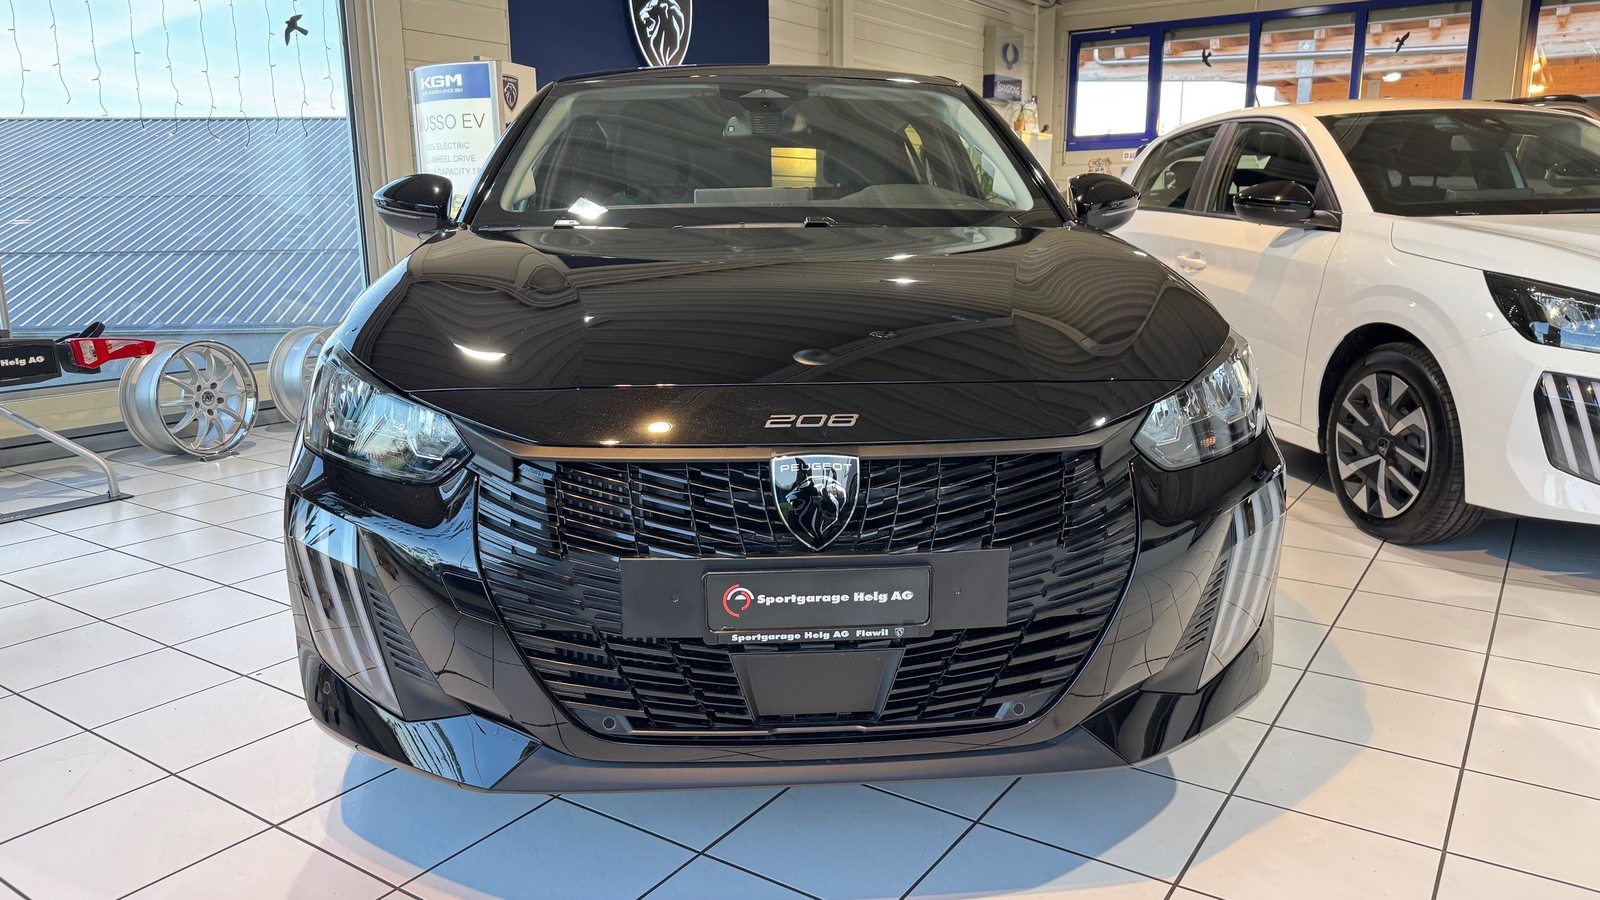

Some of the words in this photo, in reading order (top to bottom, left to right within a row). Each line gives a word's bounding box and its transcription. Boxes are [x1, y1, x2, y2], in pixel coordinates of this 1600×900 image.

[421, 74, 462, 89] KGM
[462, 113, 485, 129] EV
[436, 141, 470, 151] ELECTRIC
[453, 154, 476, 163] DRIVE
[437, 168, 470, 176] CAPACITY
[764, 413, 859, 428] 208
[780, 462, 852, 473] PEUGEOT
[757, 594, 849, 605] Sportgarage
[853, 591, 888, 603] Helg
[890, 590, 914, 601] AG
[731, 632, 801, 642] Sportgarage
[804, 631, 831, 640] Helg
[833, 630, 850, 638] AG
[855, 629, 889, 637] Flawil
